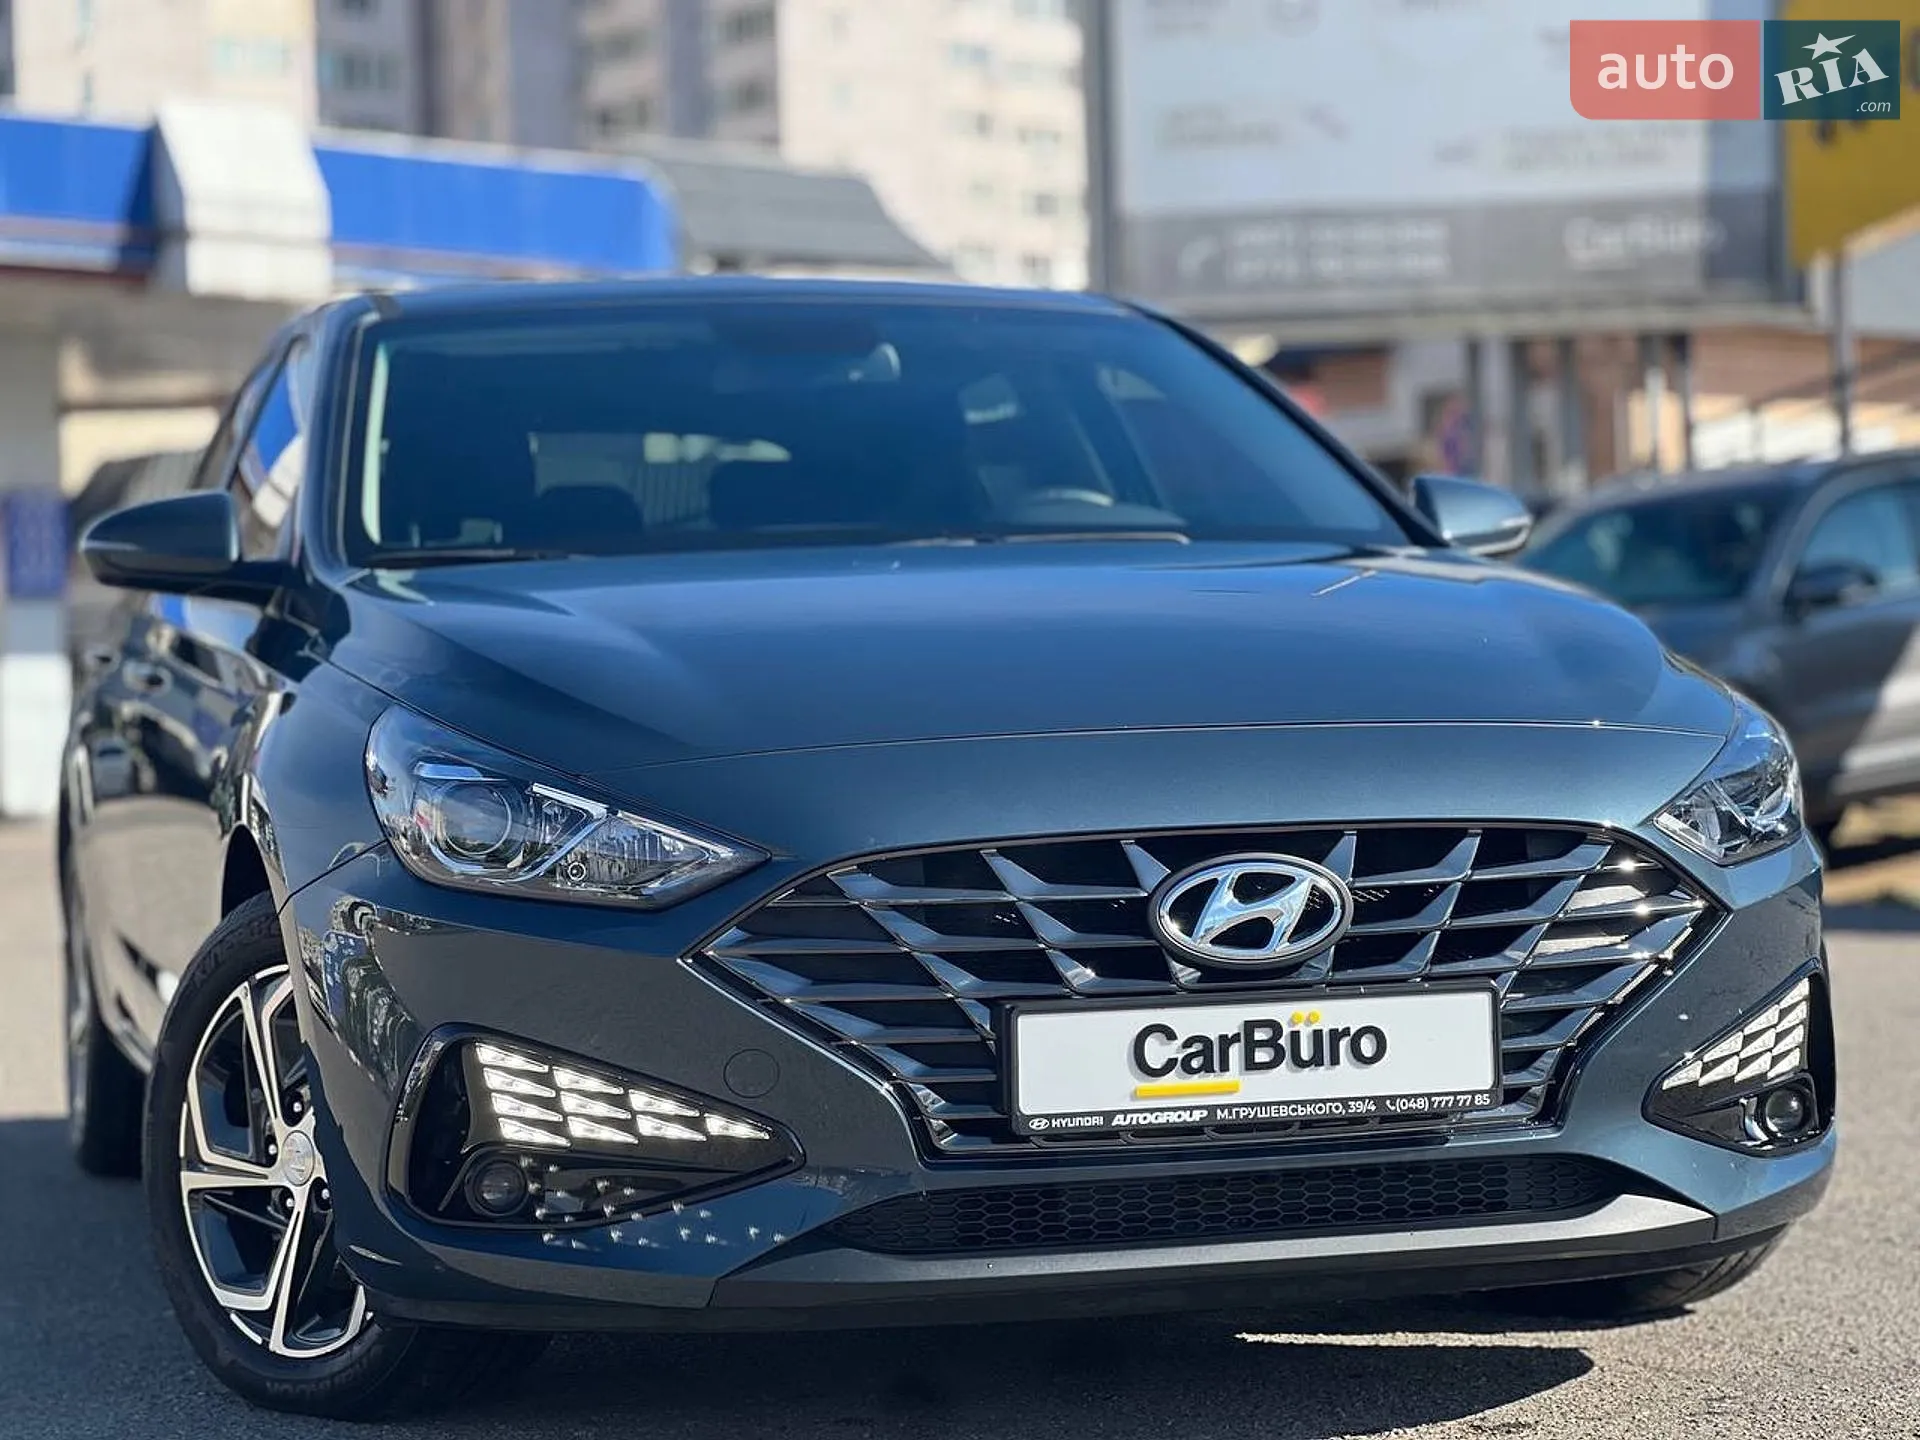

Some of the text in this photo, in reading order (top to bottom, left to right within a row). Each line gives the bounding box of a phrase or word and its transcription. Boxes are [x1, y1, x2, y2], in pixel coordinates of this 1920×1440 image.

[1133, 1010, 1388, 1078] CarBüro
[1347, 1100, 1377, 1114] 39/4
[1396, 1097, 1430, 1112] (048)
[1432, 1096, 1454, 1109] 777
[1474, 1093, 1491, 1106] 85
[1051, 1109, 1209, 1128] HYUNDAI AUTOGROUP
